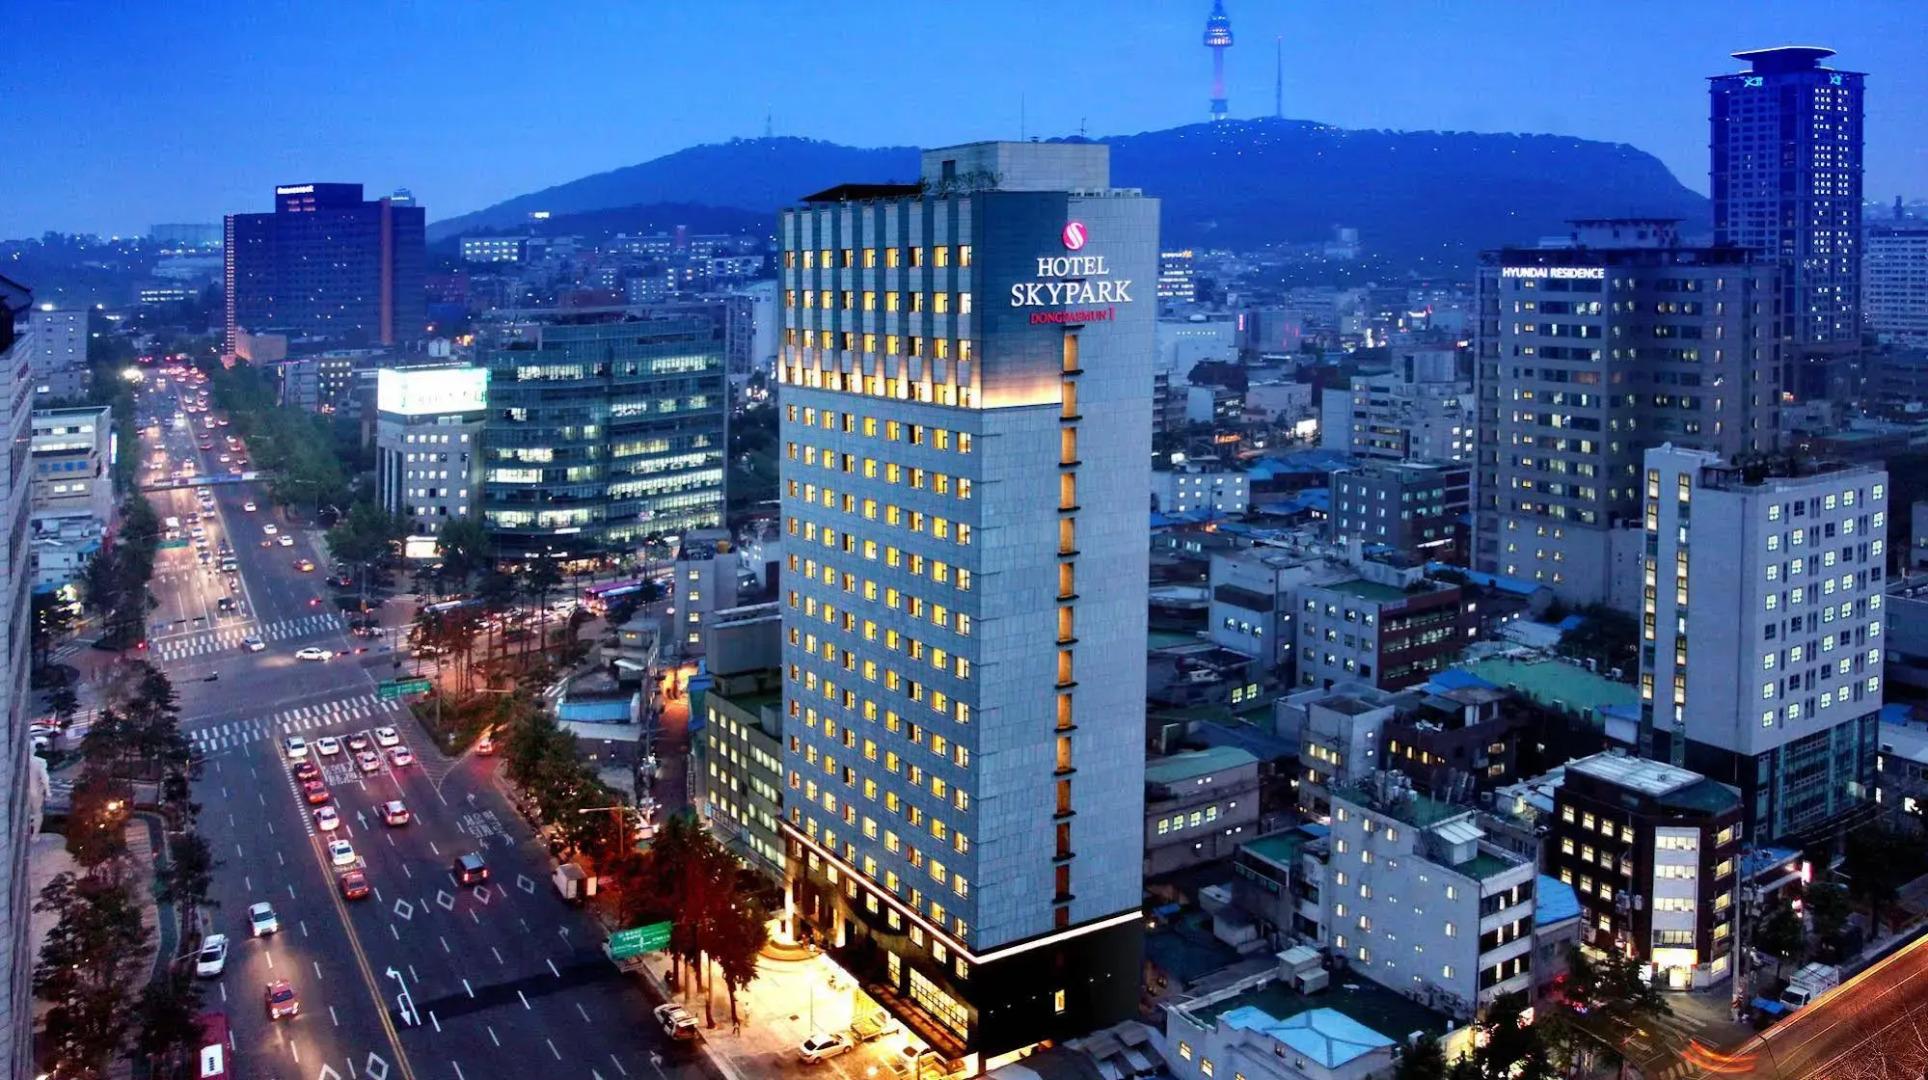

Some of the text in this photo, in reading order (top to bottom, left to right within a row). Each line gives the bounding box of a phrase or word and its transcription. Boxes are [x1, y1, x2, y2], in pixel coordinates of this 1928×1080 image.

[1037, 256, 1109, 277] HOTEL
[1502, 267, 1604, 279] HYUNDAI RESIDENCE
[1011, 280, 1133, 307] SKYPARK
[1030, 310, 1107, 325] DONGDAEMUN
